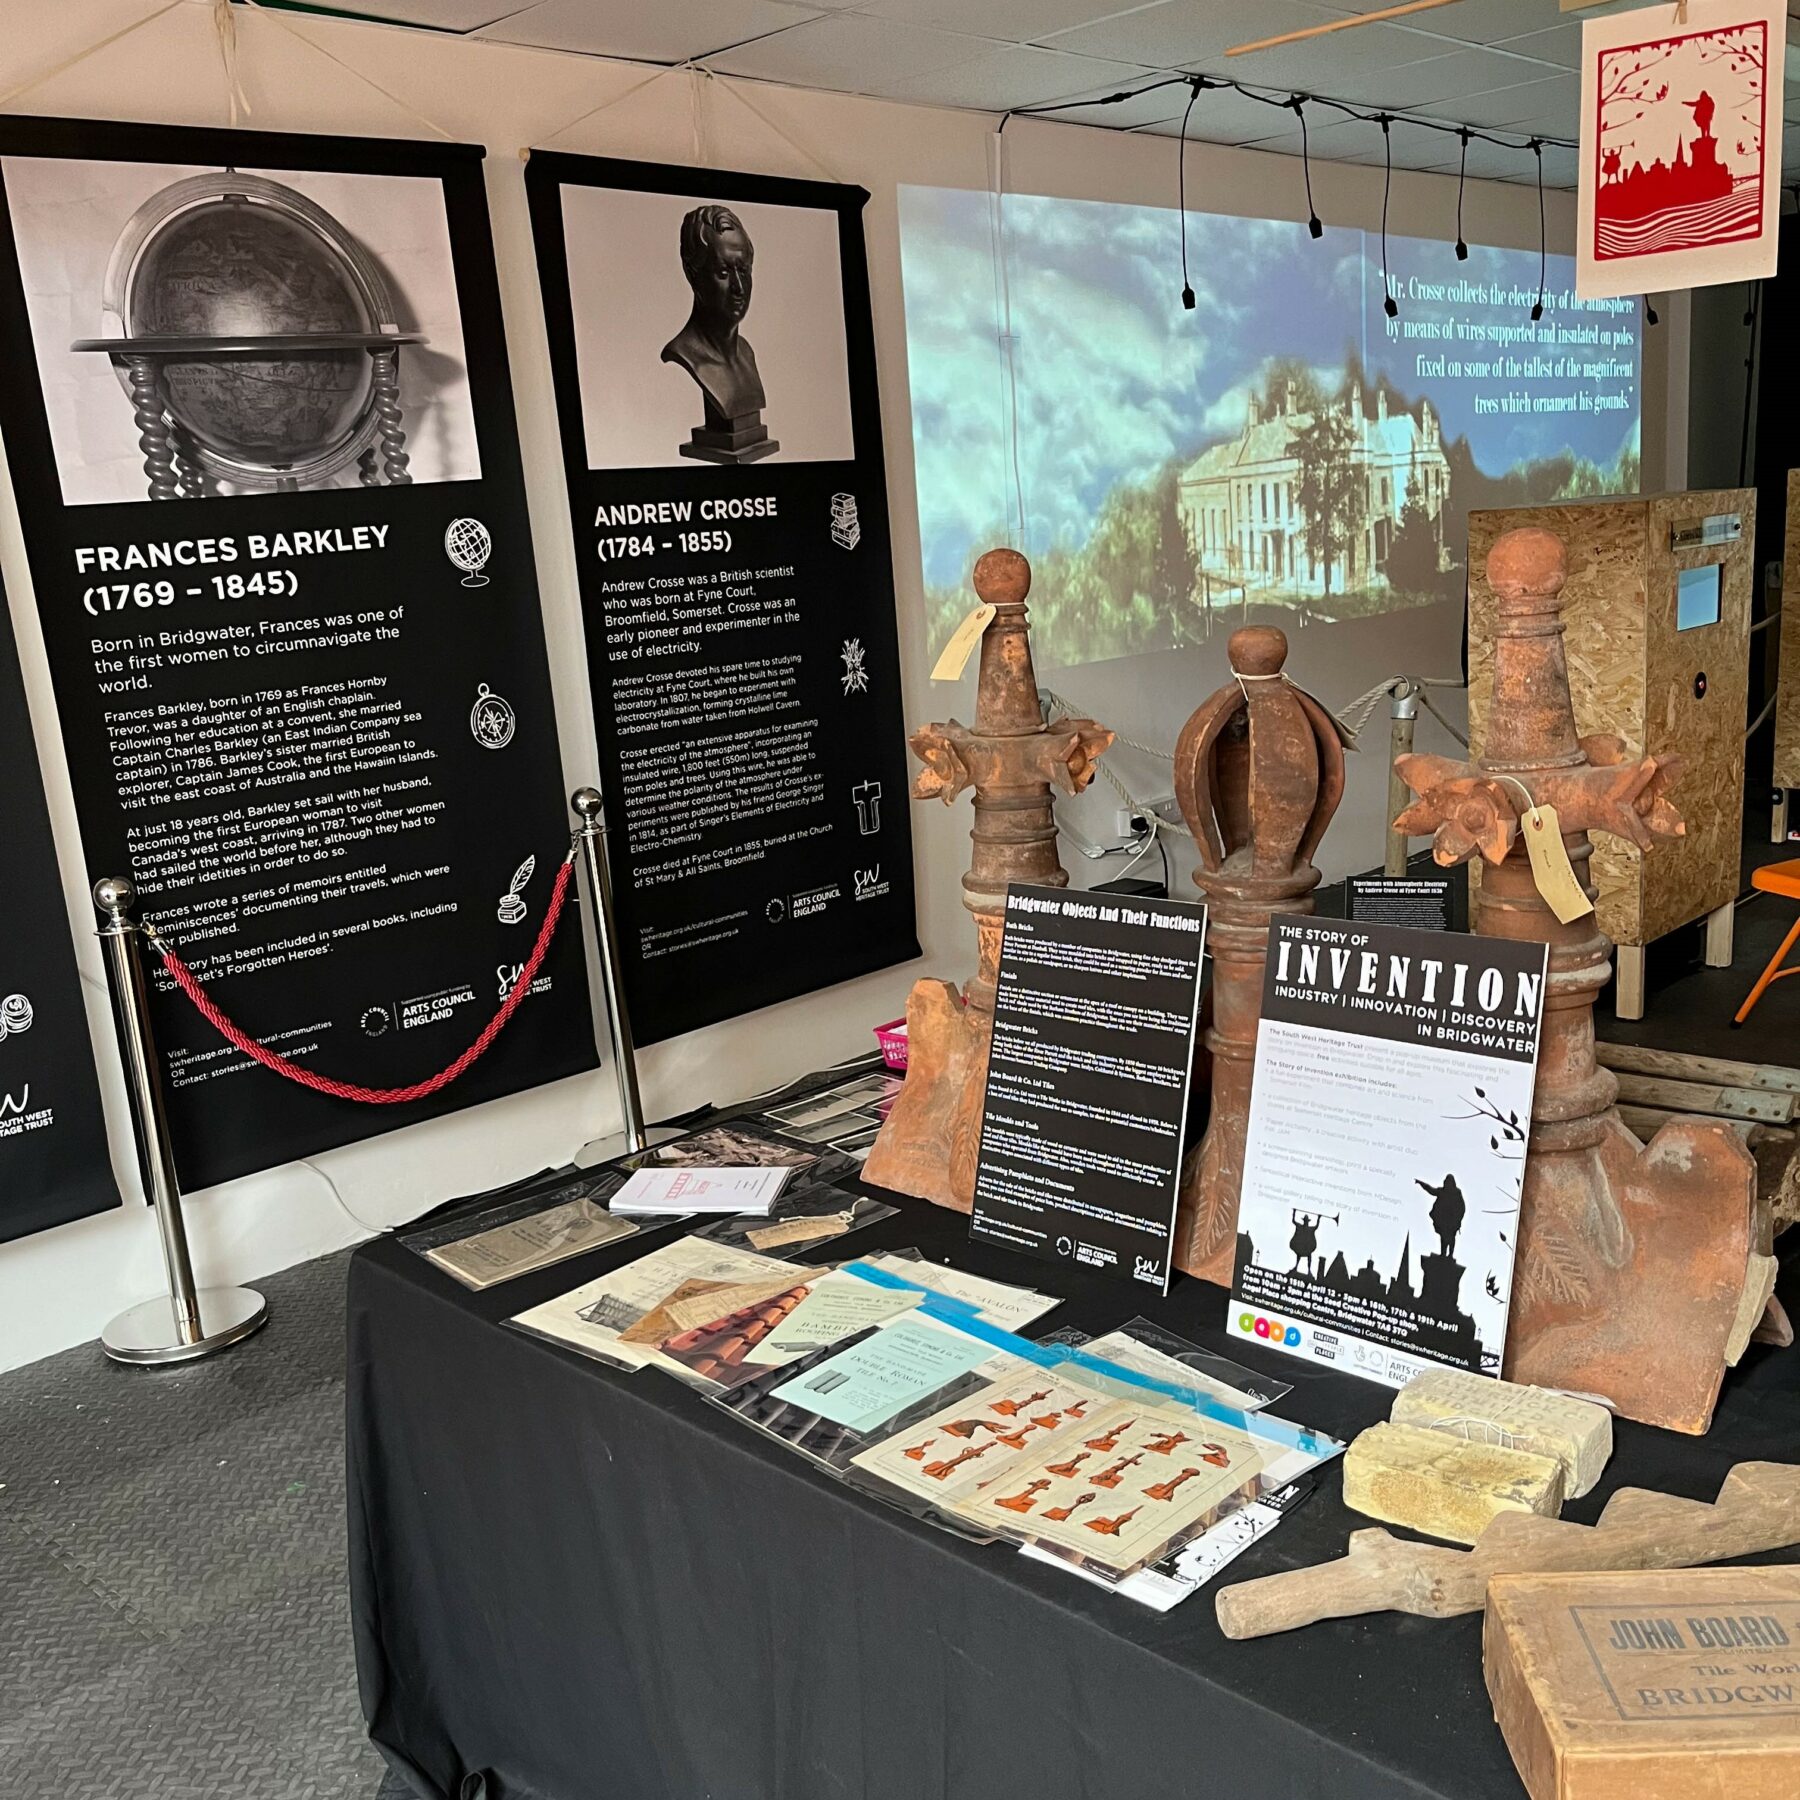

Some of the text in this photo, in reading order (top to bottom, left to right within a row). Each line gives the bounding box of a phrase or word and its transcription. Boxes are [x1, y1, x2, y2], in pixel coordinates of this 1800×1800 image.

[1408, 275, 1445, 301] Crosse
[1447, 279, 1488, 304] collects
[1489, 282, 1506, 305] the
[1558, 289, 1569, 309] of
[1385, 314, 1634, 351] by means of wires supported and insulated on poles
[1416, 354, 1633, 382] fixed on some of the tallest of the magnificent
[1474, 393, 1498, 414] trees
[1500, 391, 1531, 413] which
[1532, 392, 1577, 412] ornament
[1579, 390, 1593, 410] his
[594, 496, 777, 527] ANDREW CROSSE
[74, 524, 389, 573] FRANCES BARKLEY
[597, 535, 655, 562] (1784
[678, 530, 732, 553] 1855)
[83, 580, 174, 616] (1769
[210, 569, 298, 600] 1845)
[601, 565, 794, 593] Andrew Crosse was a British scientist
[602, 585, 756, 610] who was born at Fyne Court,
[604, 598, 796, 627] Broomfield, Somerset. Crosse was an
[90, 605, 404, 653] Born in Bridgwater, Frances was one of
[606, 611, 800, 643] early pioneer and experimenter in the
[94, 626, 399, 674] the first women to circumnavigate the
[608, 640, 702, 661] use of electricity.
[98, 674, 152, 693] world.
[104, 676, 387, 723] Frances Barkley, born in 1769 as Frances Hornby
[792, 888, 841, 908] ARTS COUNCIL
[793, 902, 826, 918] ENGLAND
[1007, 894, 1200, 932] Bridgwater Objects And Their Functions
[1279, 925, 1369, 946] THE STORY OF
[532, 976, 552, 987] WEST
[532, 983, 552, 994] TRUST
[1275, 940, 1540, 1018] INVENTION
[402, 1001, 430, 1017] ARTS
[431, 990, 476, 1009] COUNCIL
[402, 1007, 453, 1028] ENGLAND
[1274, 984, 1536, 1035] INDUSTRY INNOVATION DISCOVERY
[1417, 1023, 1536, 1054] IN BRIDGWATER
[24, 1117, 54, 1131] TRUST
[26, 1109, 52, 1122] WEST
[1075, 1252, 1104, 1267] ENGLAND
[1076, 1246, 1118, 1264] ARTS COUNCIL
[1609, 1616, 1790, 1650] JOHN BOARD
[1690, 1663, 1800, 1676] Tile Wor
[1636, 1684, 1793, 1706] BRIDGW
